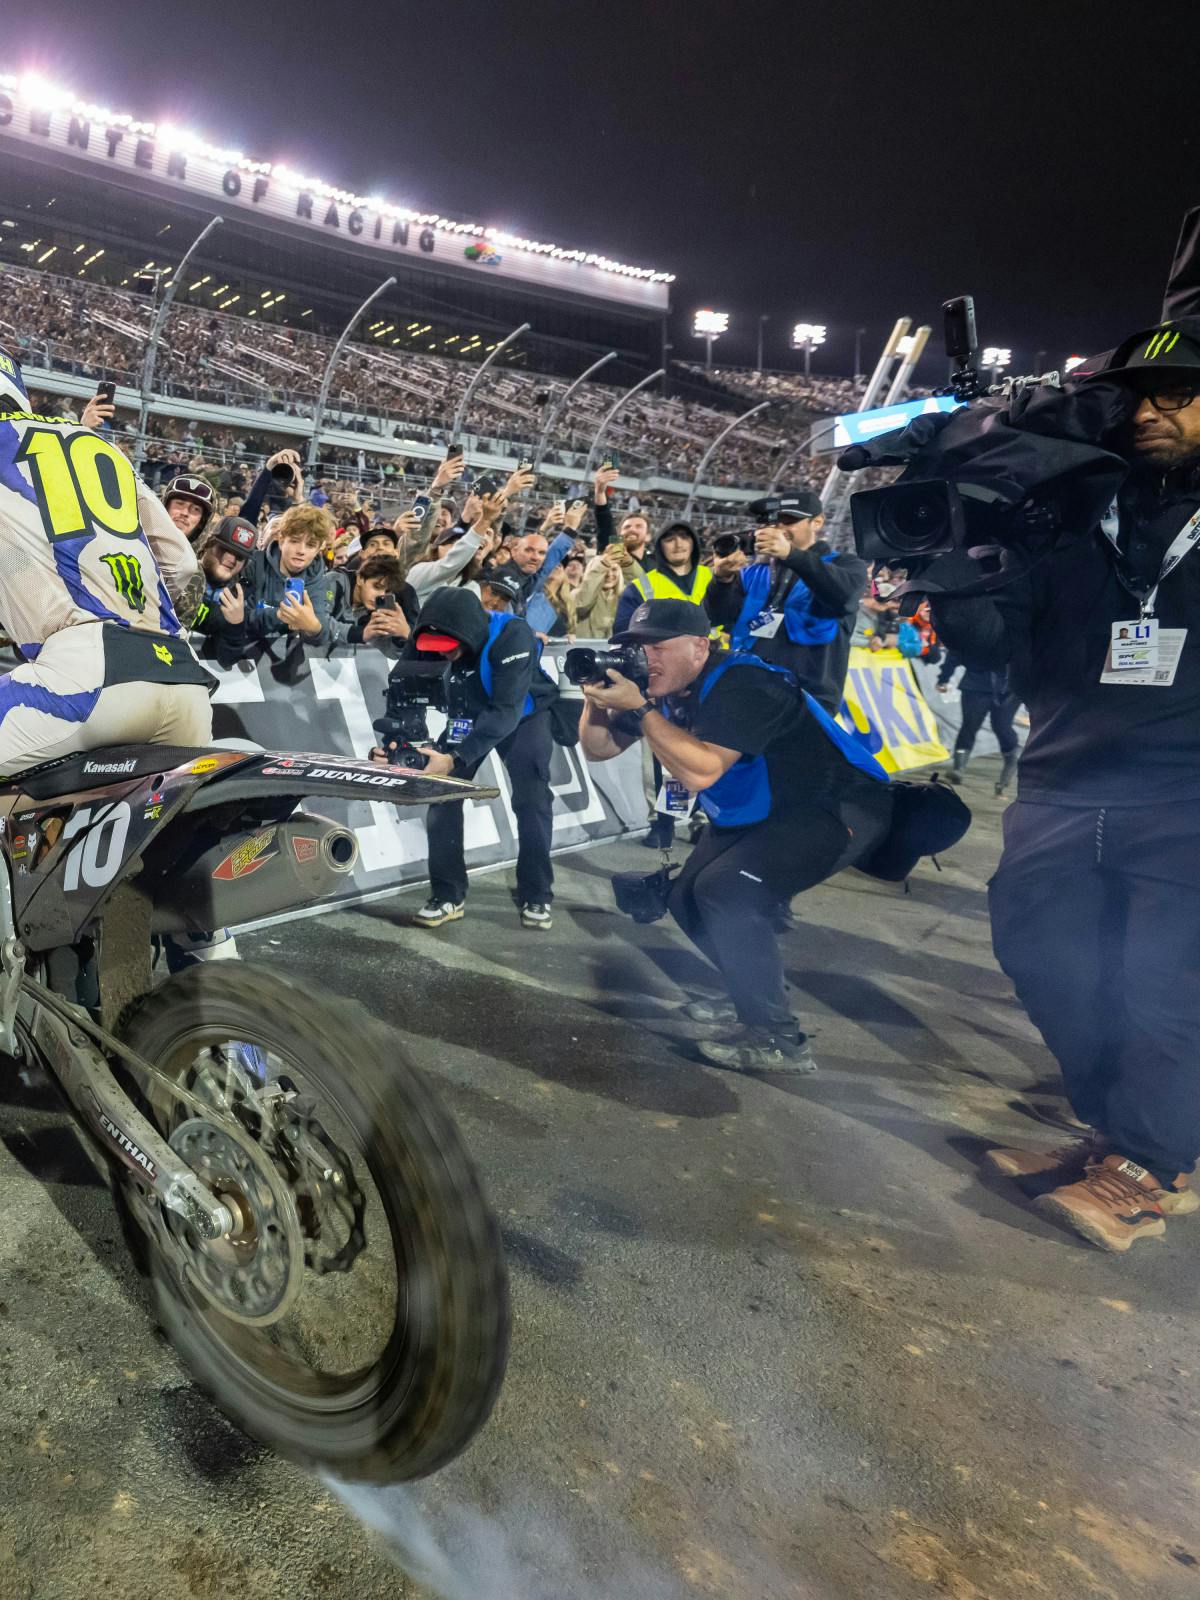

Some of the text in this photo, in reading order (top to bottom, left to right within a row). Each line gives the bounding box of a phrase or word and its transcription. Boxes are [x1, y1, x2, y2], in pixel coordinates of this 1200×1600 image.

[223, 170, 269, 203] OF
[297, 193, 435, 253] RACING
[16, 427, 142, 543] 10
[1135, 625, 1150, 639] L1
[840, 667, 933, 756] UKI
[83, 759, 137, 773] Kawasaki
[306, 768, 407, 788] DUNLOP
[63, 801, 131, 892] 10
[100, 1114, 157, 1178] ENTHAL
